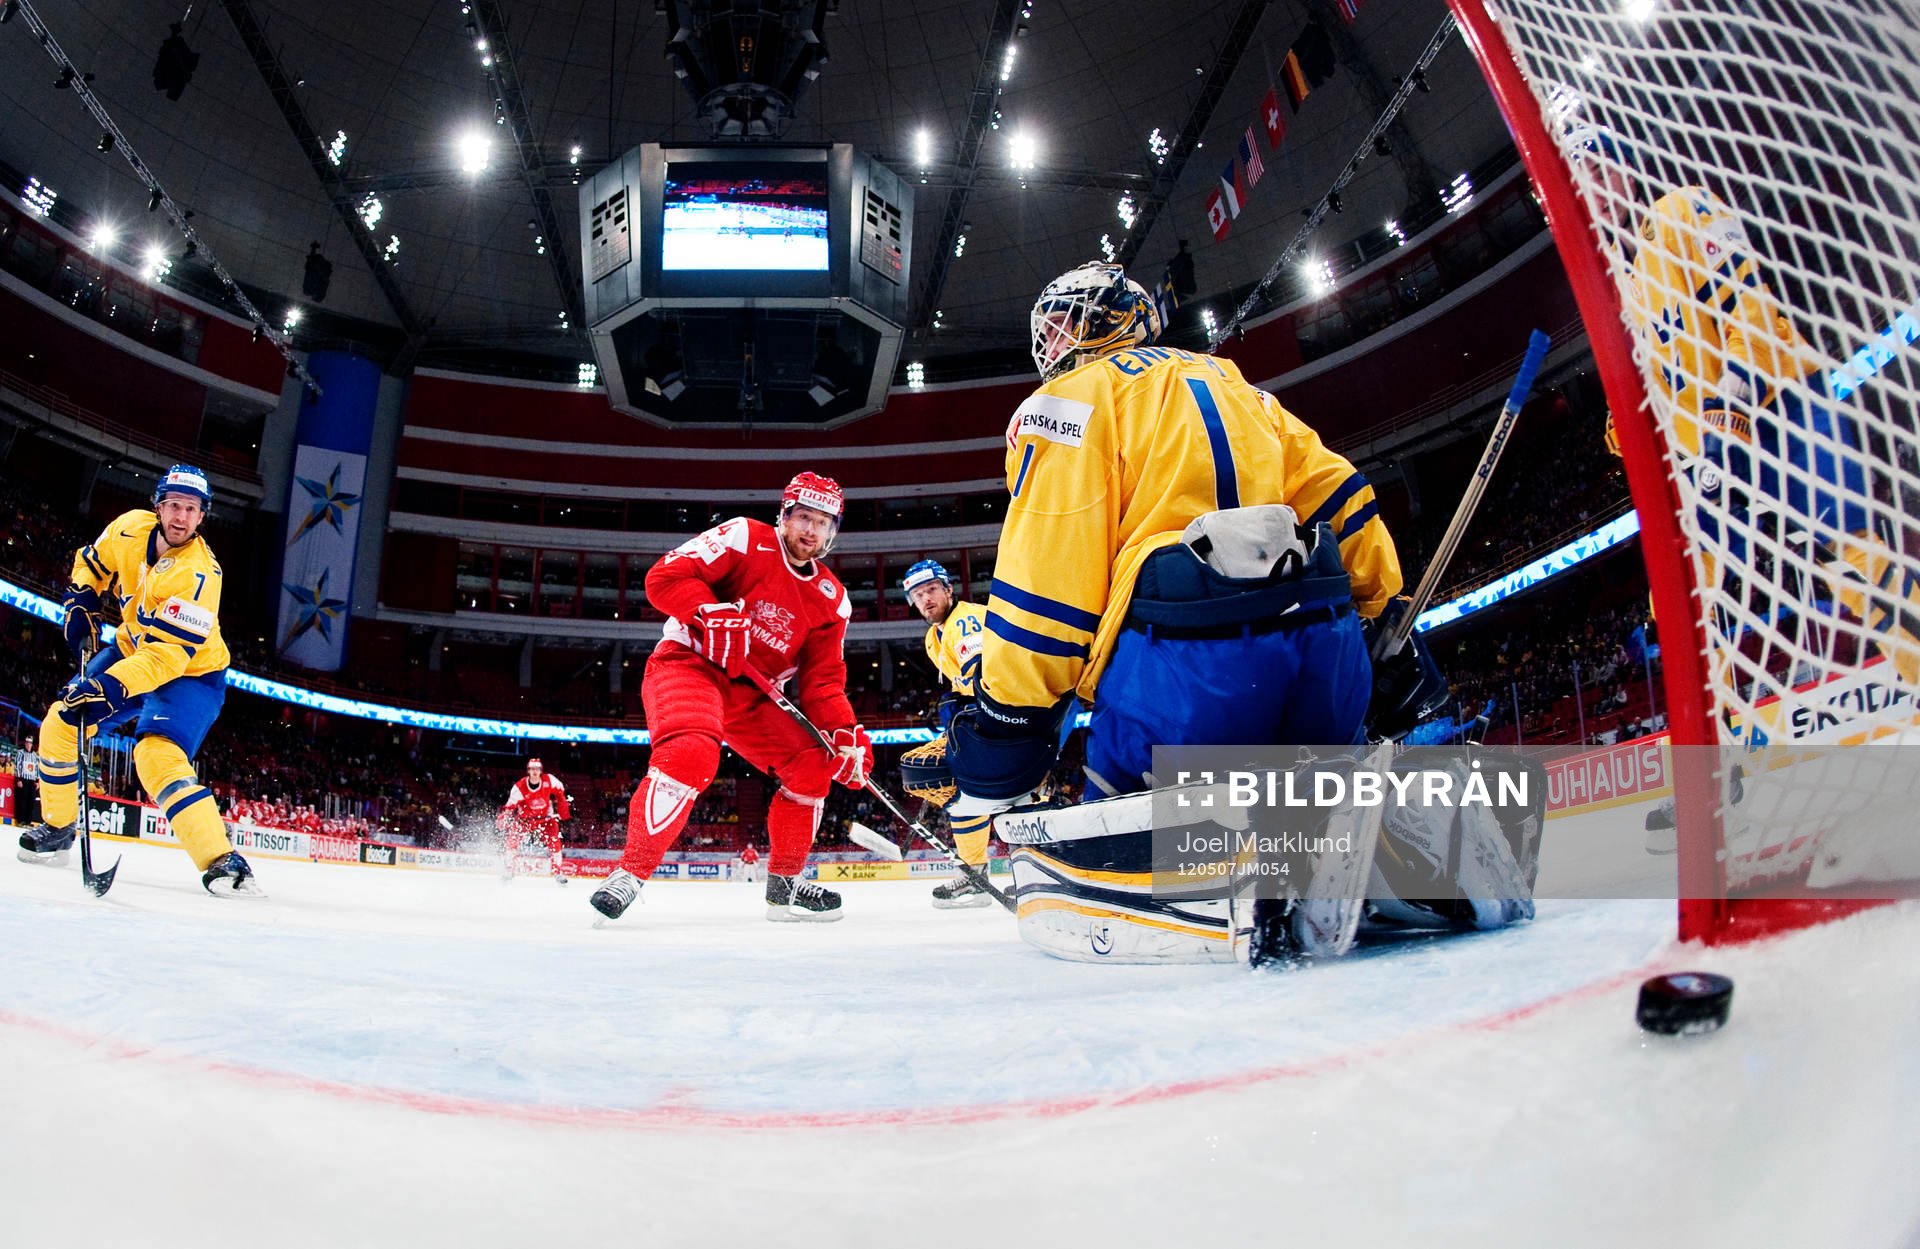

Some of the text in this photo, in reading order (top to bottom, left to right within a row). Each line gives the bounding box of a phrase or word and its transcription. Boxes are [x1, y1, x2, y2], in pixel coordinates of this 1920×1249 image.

[1060, 421, 1082, 438] SPEL
[803, 490, 839, 508] DONG
[194, 572, 206, 601] 7
[956, 615, 982, 637] 23
[980, 702, 1029, 725] Reebok
[1005, 817, 1053, 843] Reebok
[253, 831, 291, 851] TISSOT
[690, 865, 718, 875] NIVEA
[852, 871, 876, 879] BANK
